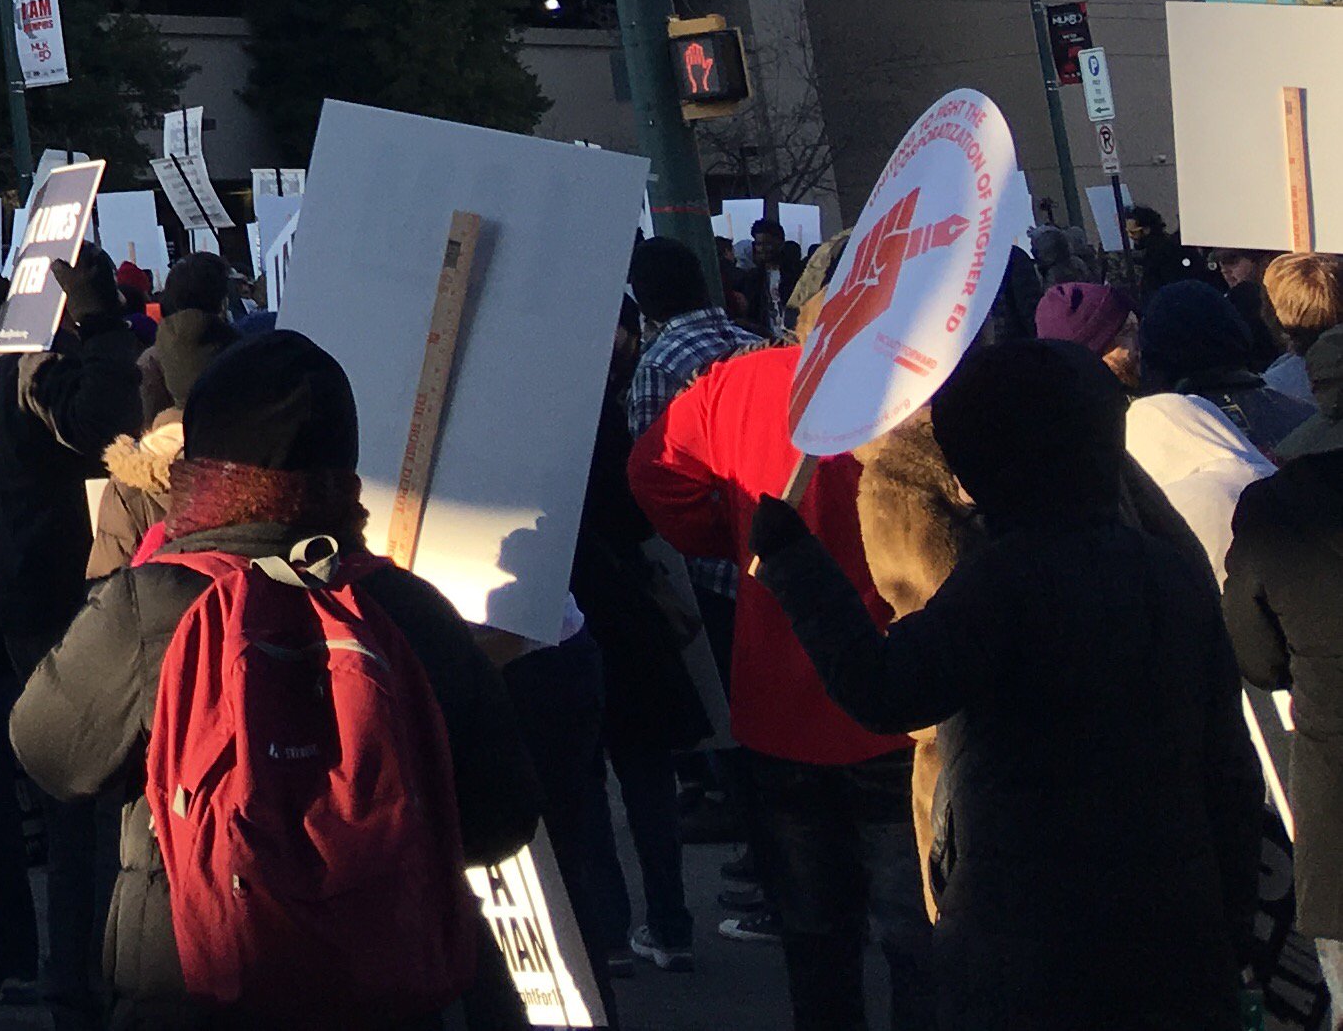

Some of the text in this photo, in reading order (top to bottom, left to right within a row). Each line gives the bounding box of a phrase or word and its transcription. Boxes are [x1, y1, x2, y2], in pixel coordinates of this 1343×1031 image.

[965, 101, 988, 129] THE
[977, 173, 993, 200] OF
[35, 201, 83, 243] LIVES
[961, 207, 993, 297] HIGHER
[945, 305, 968, 334] ED
